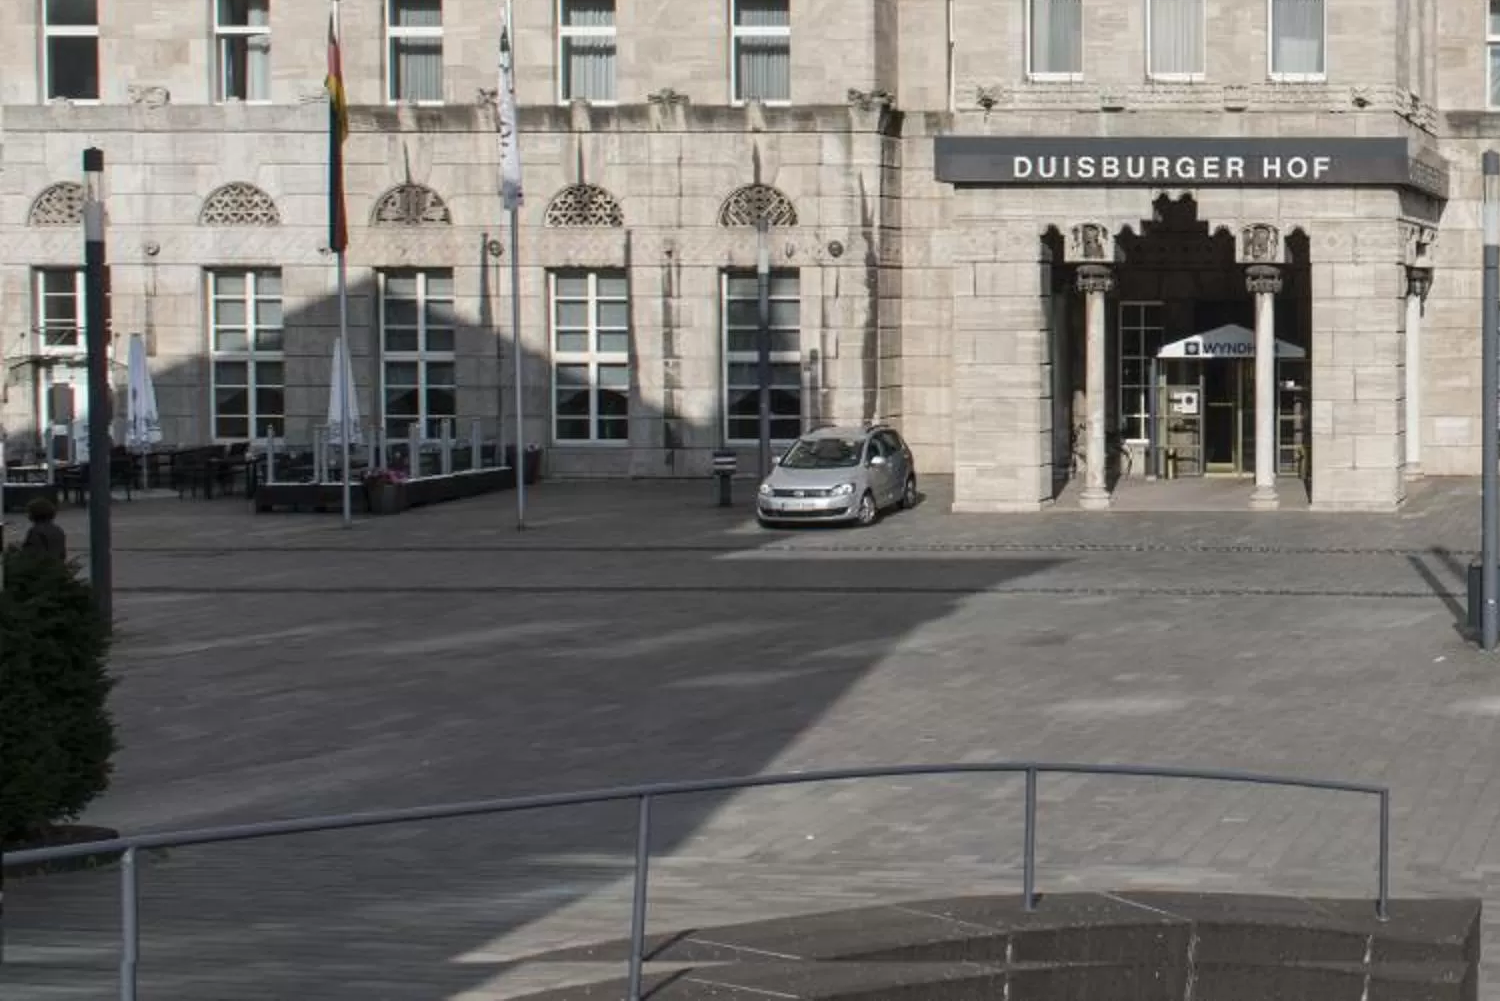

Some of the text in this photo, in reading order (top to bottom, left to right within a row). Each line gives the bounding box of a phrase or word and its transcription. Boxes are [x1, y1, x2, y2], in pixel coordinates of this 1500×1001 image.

[1012, 155, 1332, 179] DUISBURGER HOF
[1203, 342, 1280, 354] WYNDH
